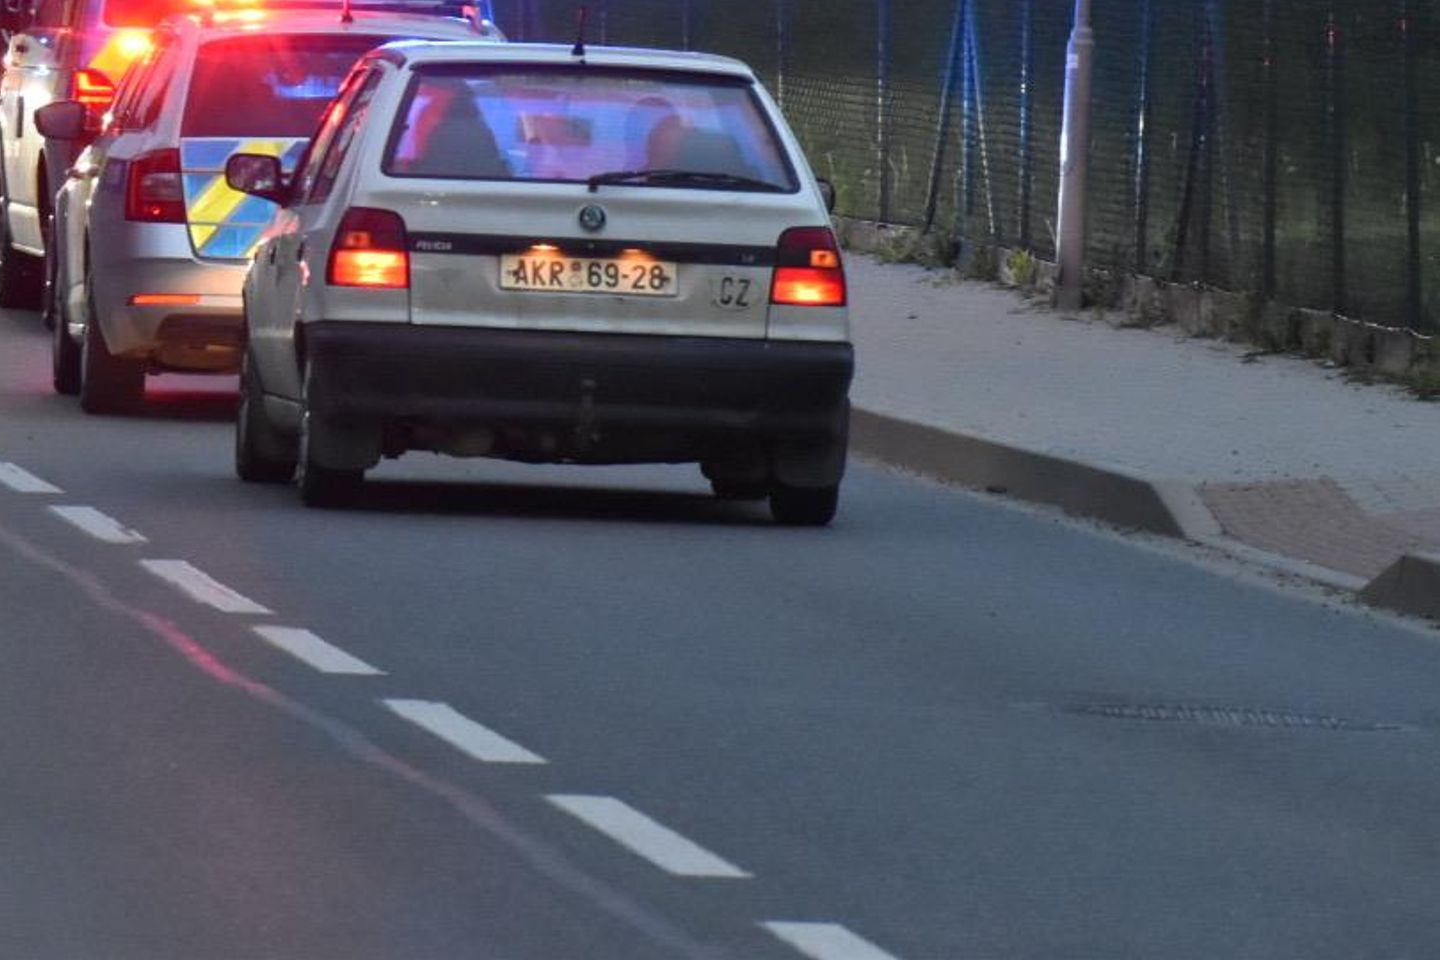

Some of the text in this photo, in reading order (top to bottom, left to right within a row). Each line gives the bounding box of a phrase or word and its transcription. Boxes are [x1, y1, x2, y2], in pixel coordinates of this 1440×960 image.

[515, 259, 665, 290] AKR 69-28
[720, 276, 751, 307] CZ
